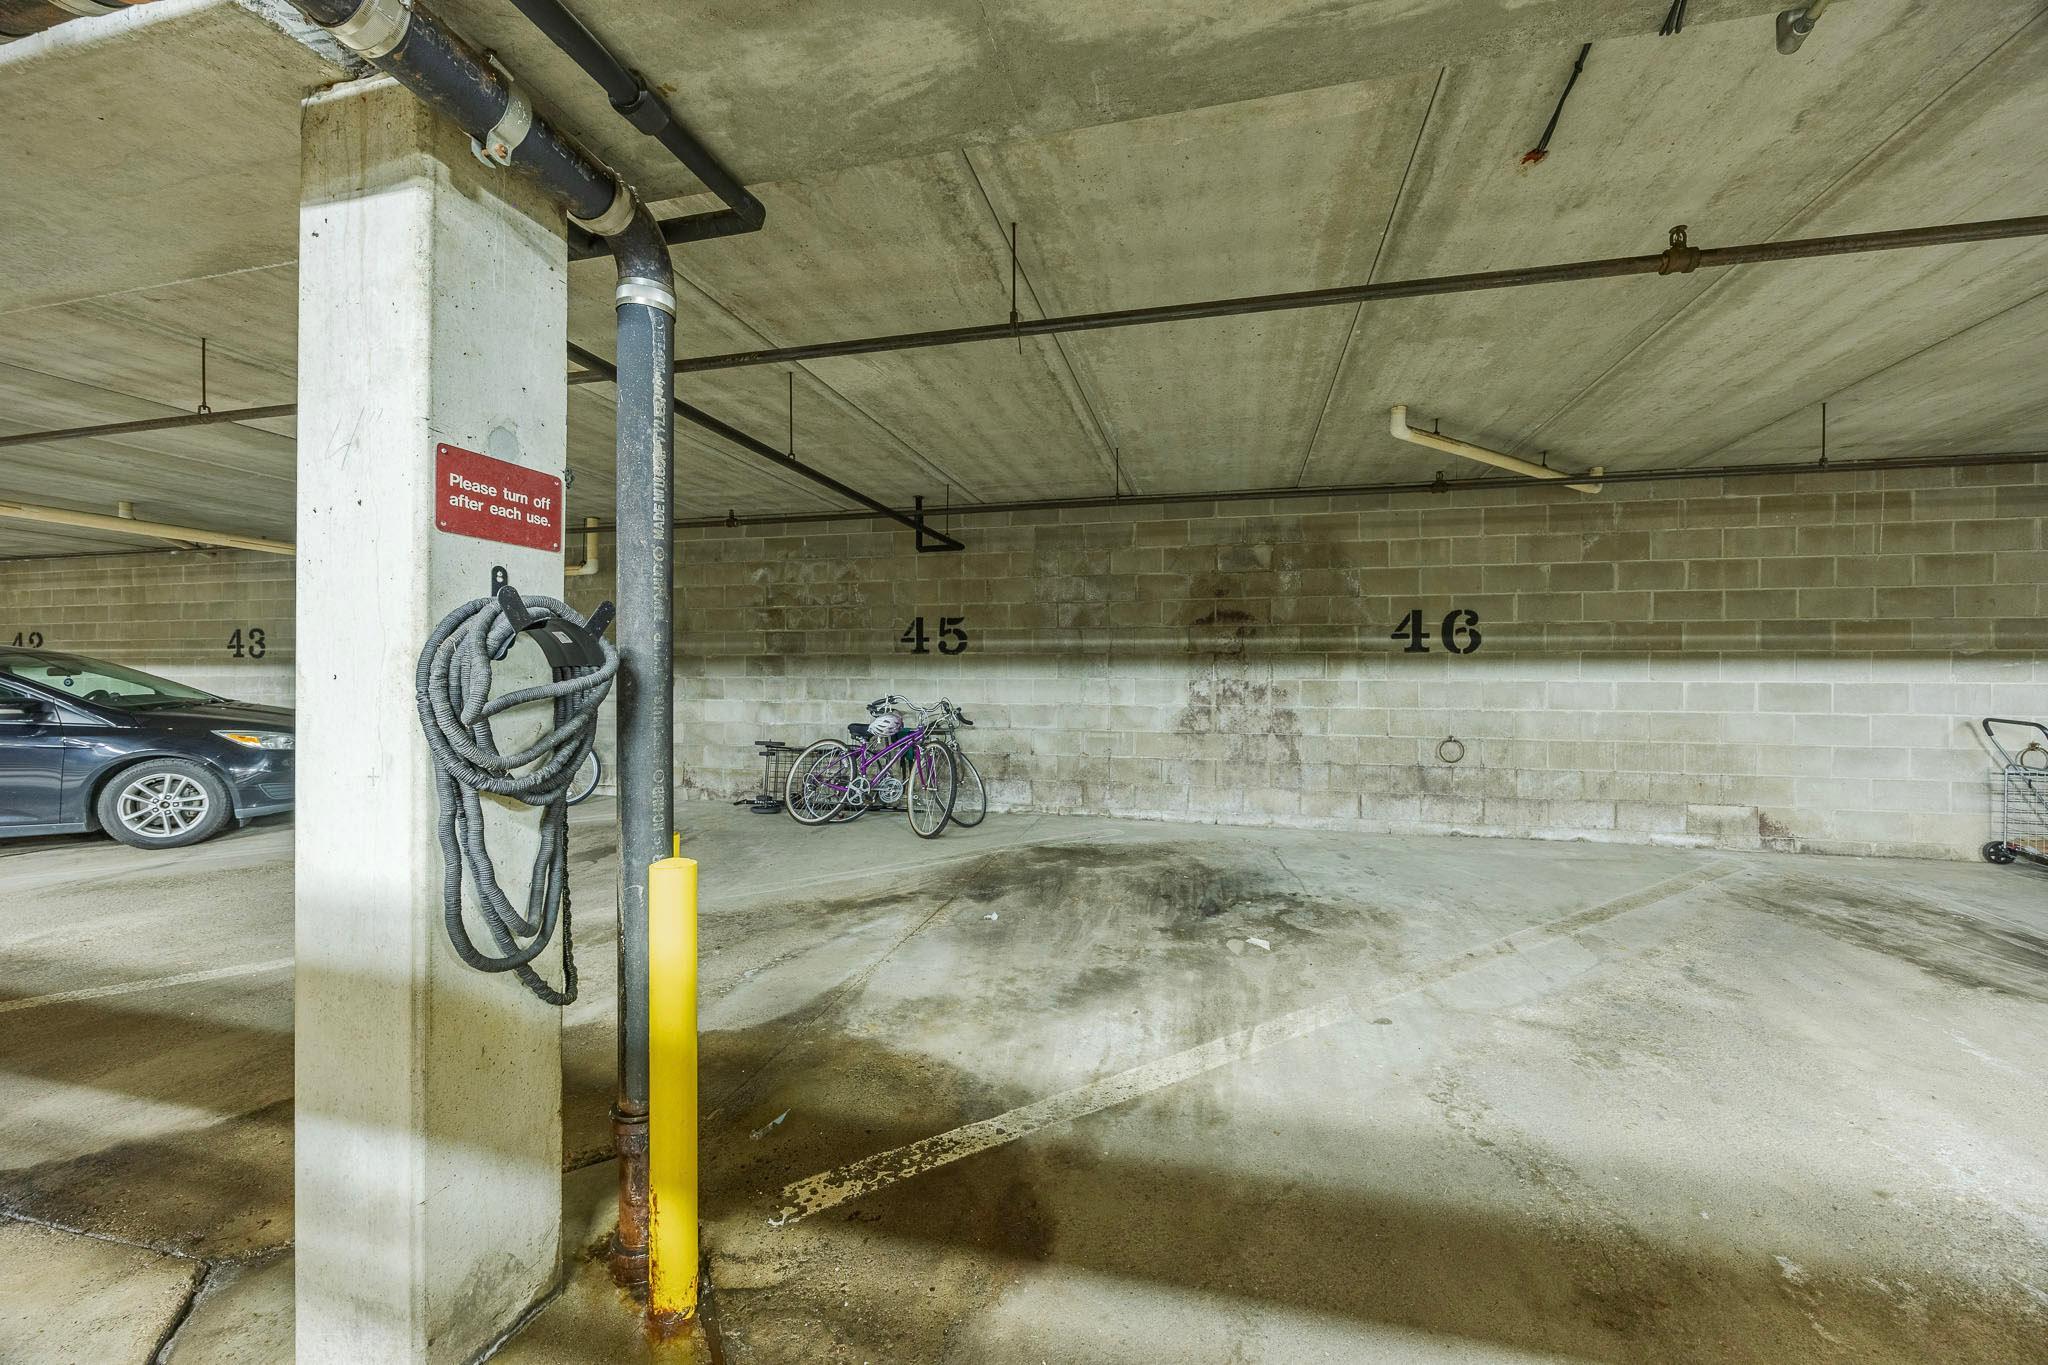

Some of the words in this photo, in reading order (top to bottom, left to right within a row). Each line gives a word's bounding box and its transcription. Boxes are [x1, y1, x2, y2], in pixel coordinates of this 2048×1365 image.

[450, 473, 498, 497] Please
[502, 487, 529, 505] turn
[533, 496, 551, 511] off
[450, 494, 485, 512] after
[489, 504, 522, 521] each
[526, 513, 551, 528] use.
[652, 502, 665, 540] MADE
[227, 627, 266, 659] 43
[901, 616, 968, 656] 45
[1390, 609, 1482, 655] 46
